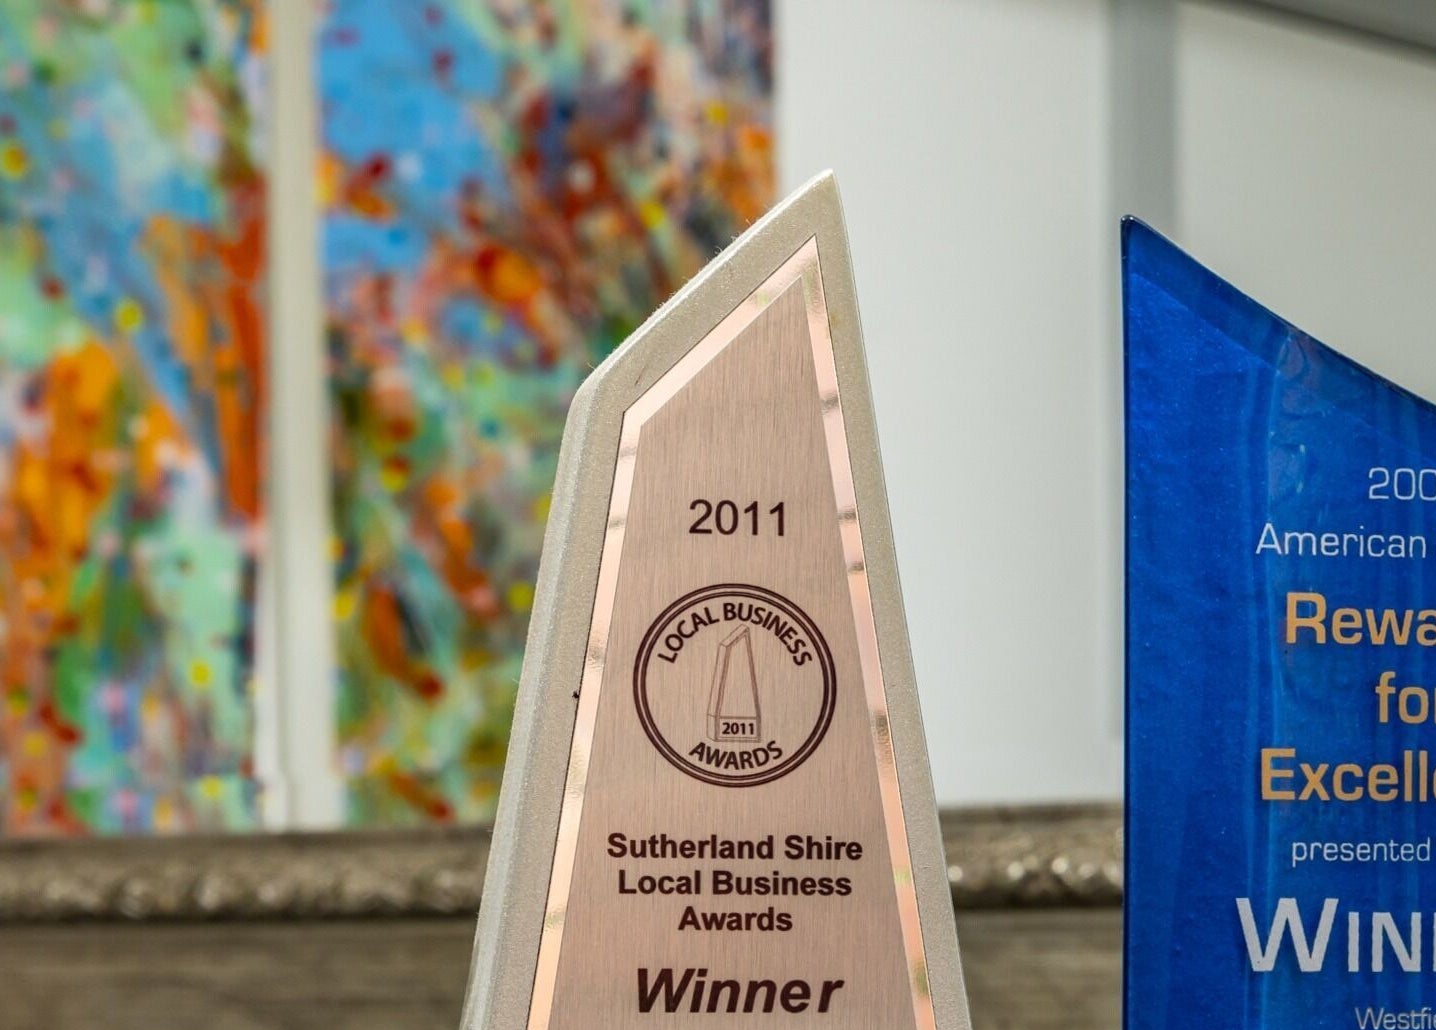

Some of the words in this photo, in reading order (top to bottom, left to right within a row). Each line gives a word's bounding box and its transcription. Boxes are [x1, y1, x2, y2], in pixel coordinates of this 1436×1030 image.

[688, 498, 785, 537] 2011
[1255, 522, 1427, 558] American
[657, 606, 720, 664] LOCAL
[723, 602, 812, 667] BUSINESS
[721, 722, 755, 736] 2011
[688, 740, 784, 770] AWARDS
[607, 832, 774, 860] Sutherland
[784, 834, 863, 861] Shire
[1291, 837, 1431, 868] presented
[618, 869, 701, 895] Local
[712, 870, 852, 896] Business
[678, 905, 793, 932] Awards
[637, 967, 845, 1014] Winner
